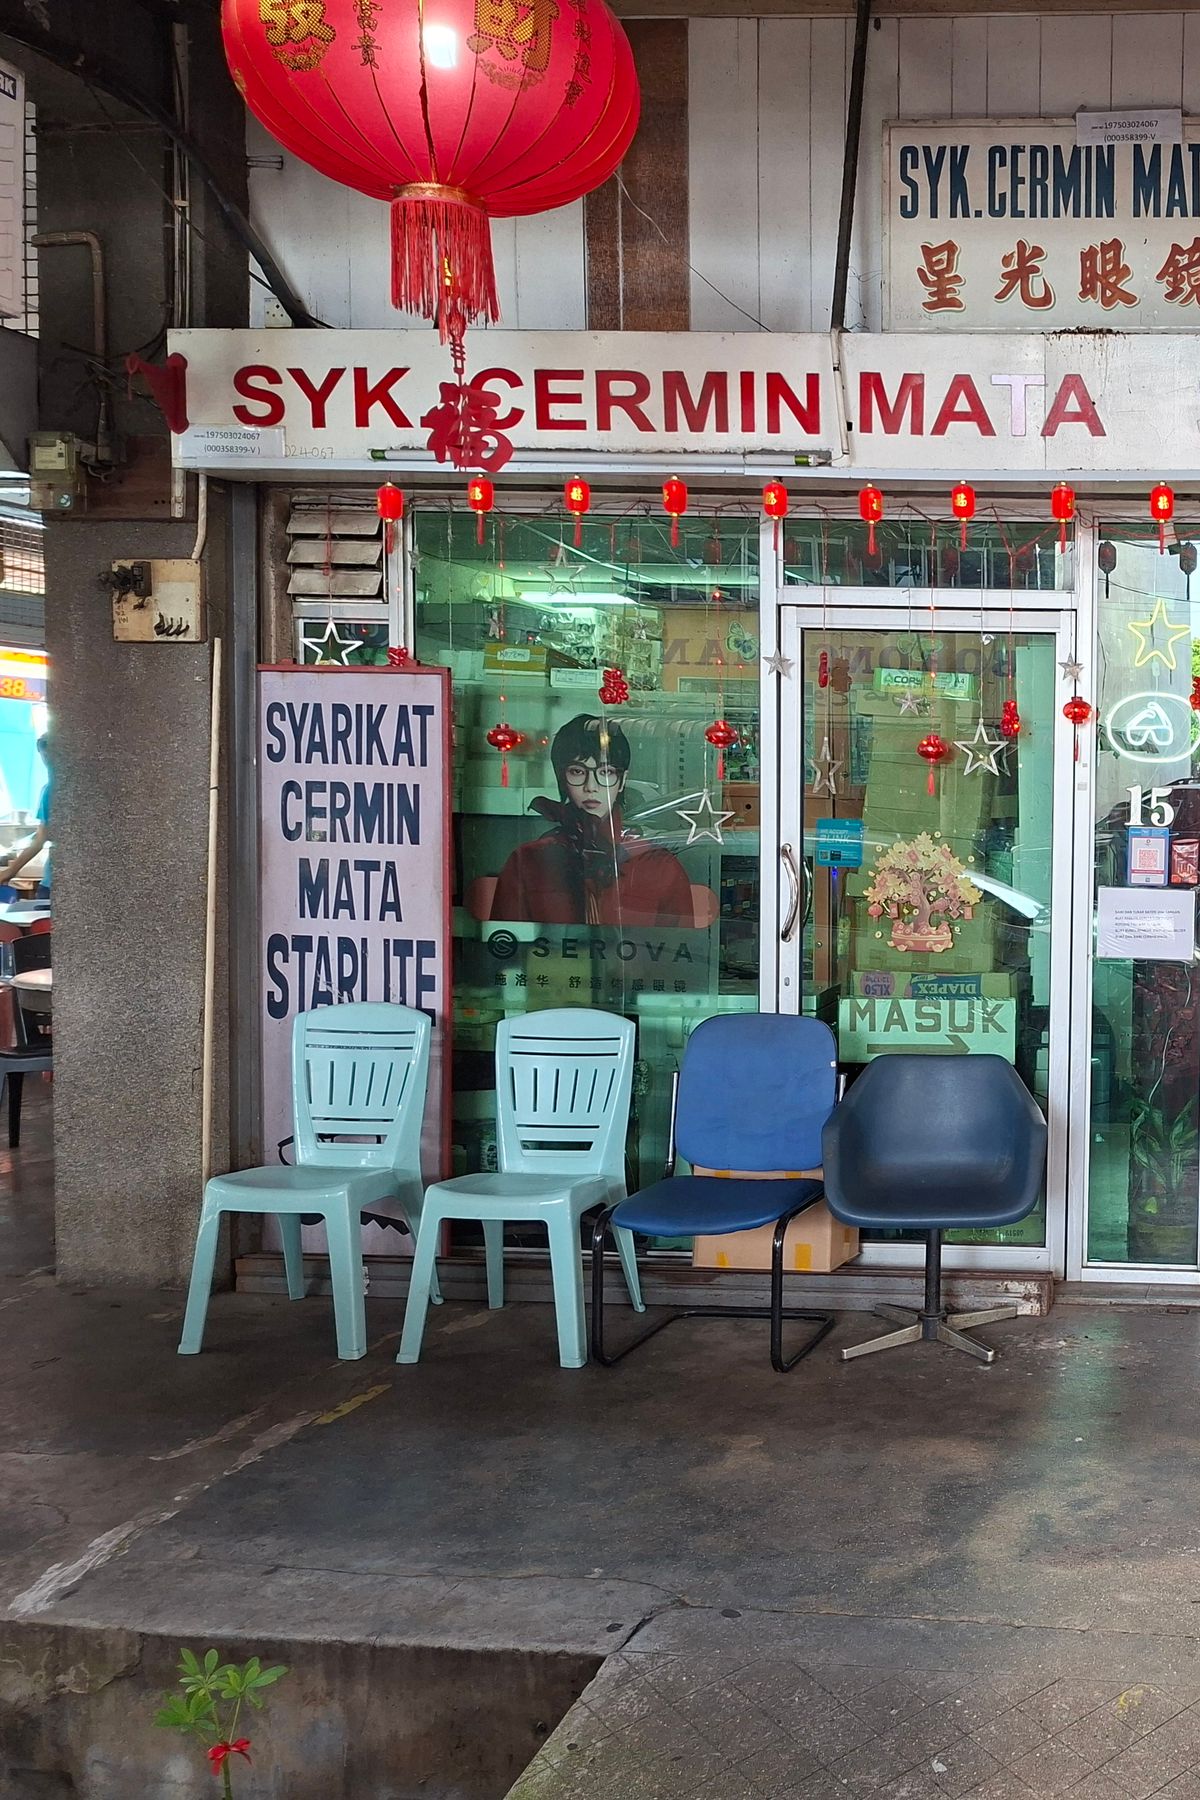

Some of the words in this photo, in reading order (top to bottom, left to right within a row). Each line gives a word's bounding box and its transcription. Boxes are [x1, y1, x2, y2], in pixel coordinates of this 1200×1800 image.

[900, 144, 1115, 218] SYK.CERMIN
[859, 371, 1107, 436] MATA
[206, 431, 260, 440] 197503024067
[266, 702, 435, 767] SYARIKAT
[281, 780, 420, 845] CERMIN
[1125, 785, 1174, 827] 15
[299, 857, 402, 922] MATA
[532, 936, 694, 963] SEROVA
[865, 984, 891, 996] XL50
[918, 983, 977, 994] DIAPEX
[850, 999, 1008, 1033] MASUK
